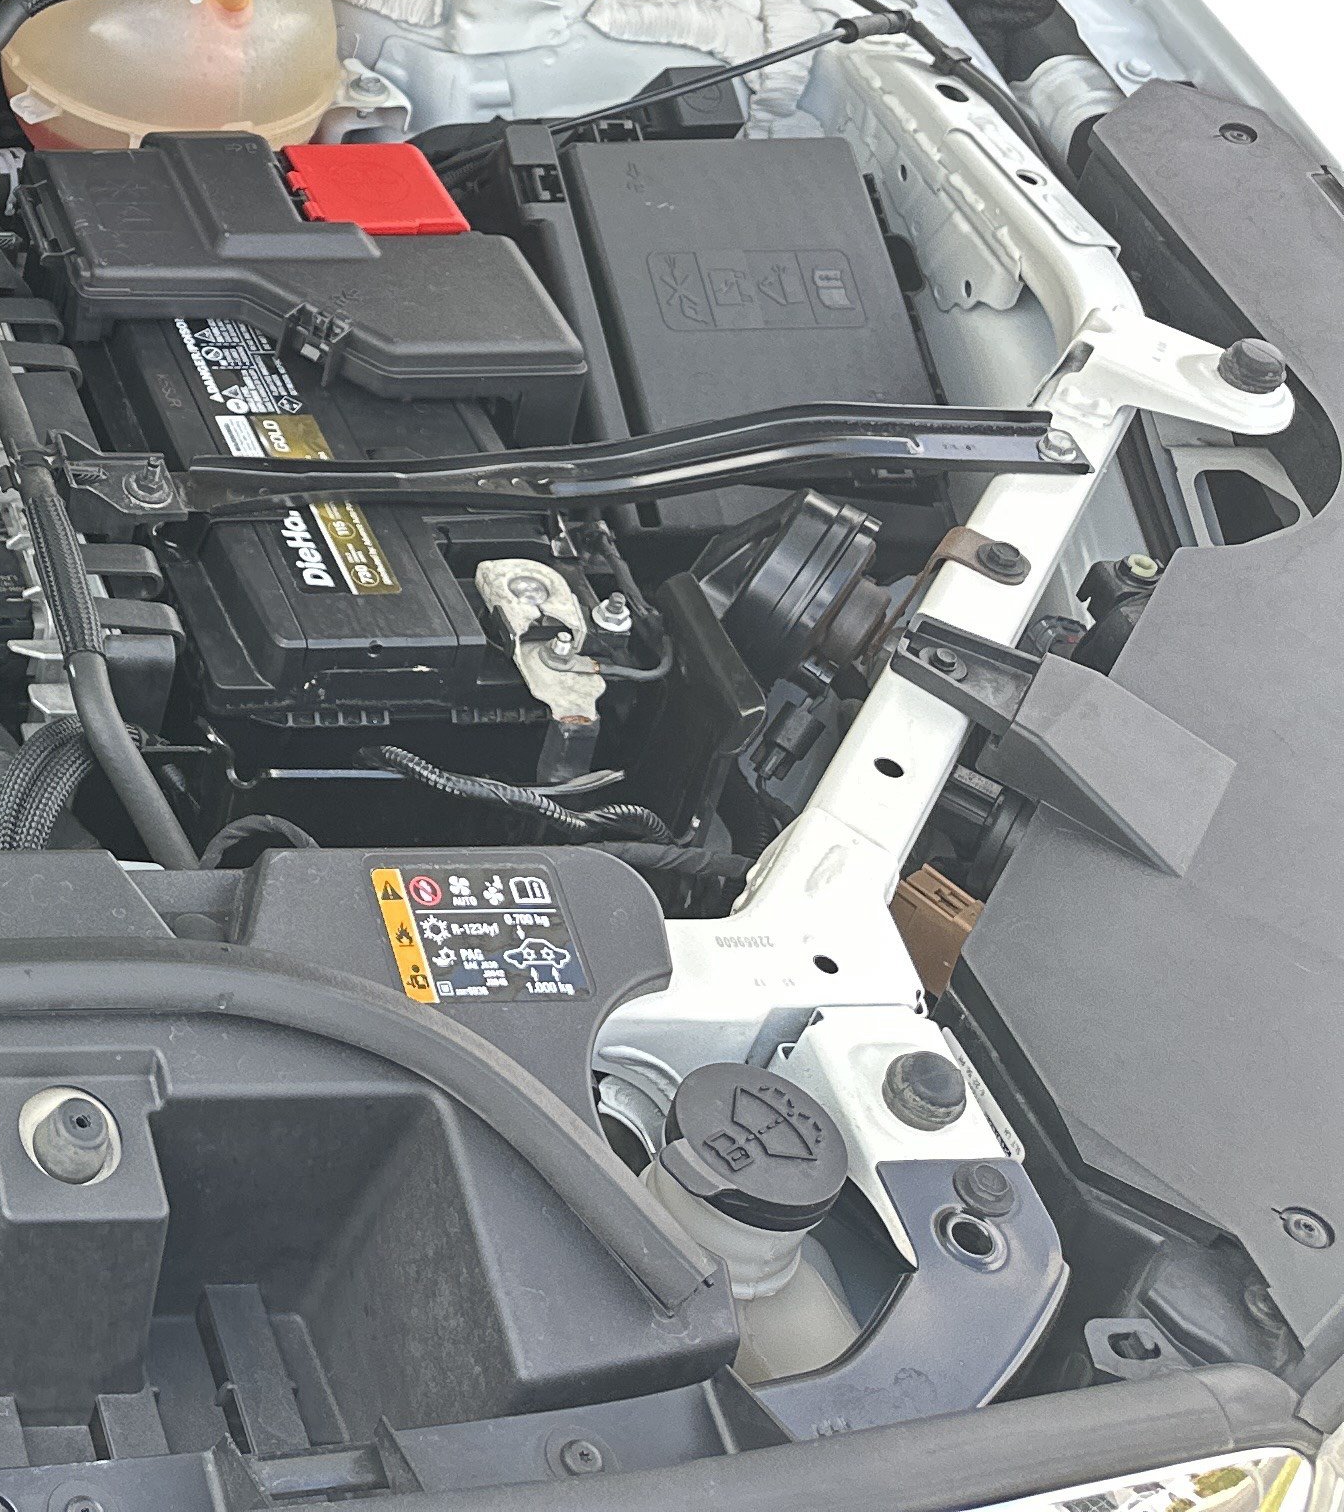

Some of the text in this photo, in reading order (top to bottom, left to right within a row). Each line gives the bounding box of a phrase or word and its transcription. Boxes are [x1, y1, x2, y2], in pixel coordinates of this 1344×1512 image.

[262, 418, 291, 453] GOLD
[453, 896, 478, 906] AUTO
[534, 914, 551, 928] kg
[459, 948, 485, 961] PAG
[557, 981, 576, 996] kg
